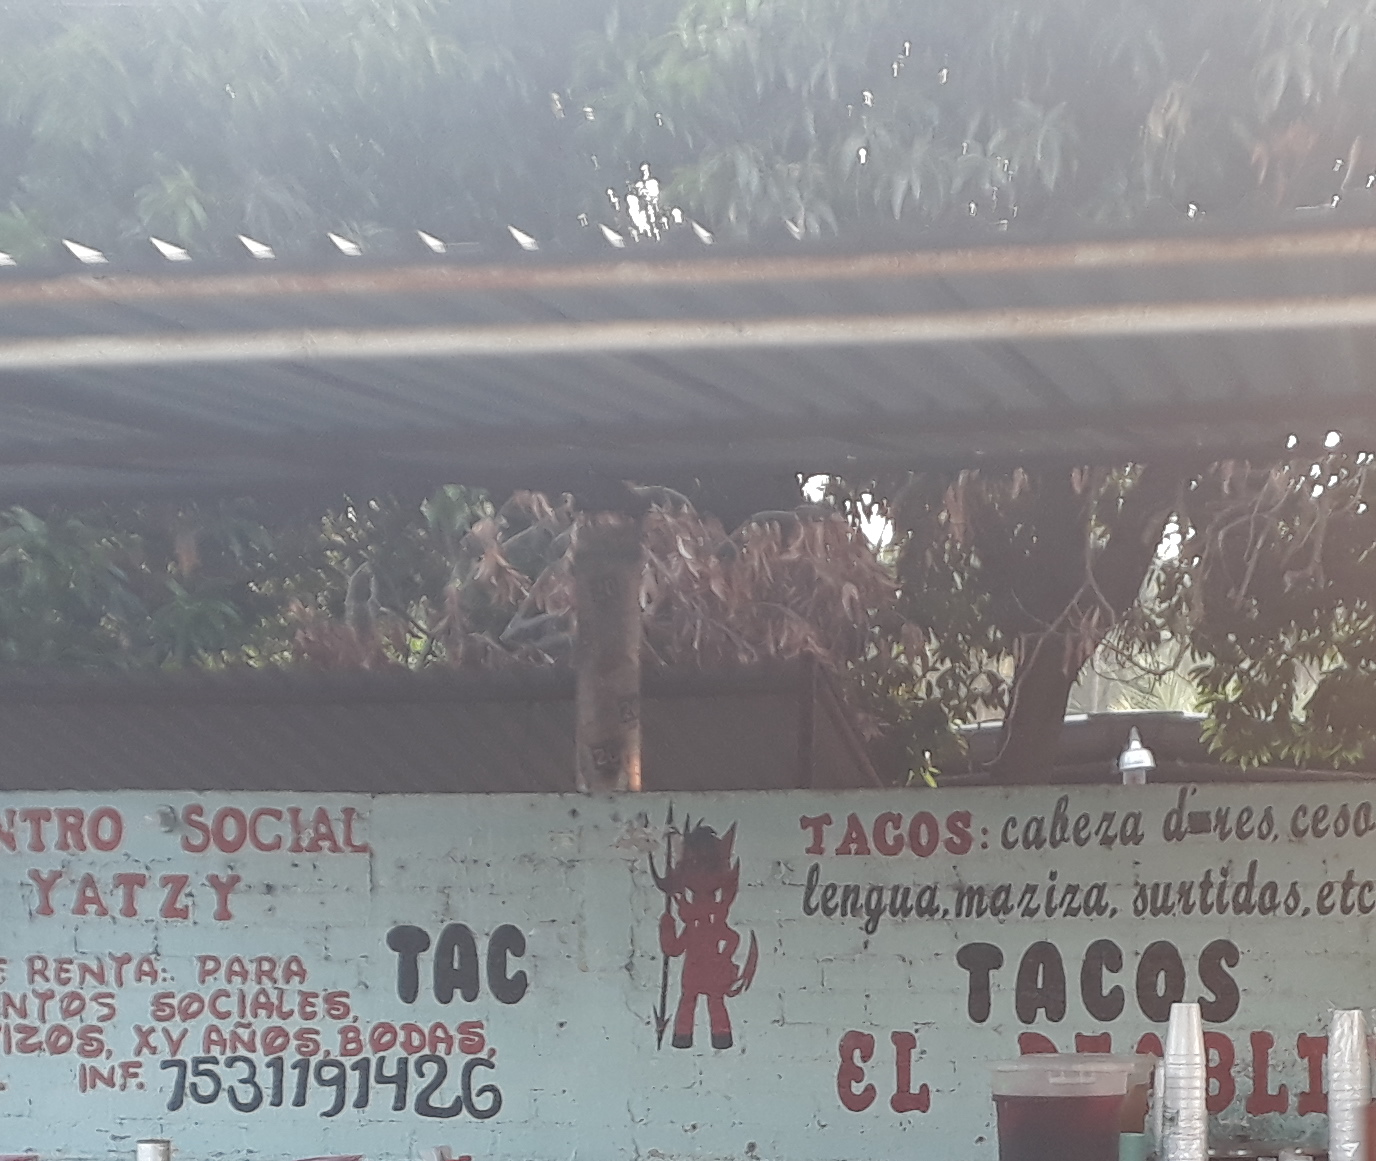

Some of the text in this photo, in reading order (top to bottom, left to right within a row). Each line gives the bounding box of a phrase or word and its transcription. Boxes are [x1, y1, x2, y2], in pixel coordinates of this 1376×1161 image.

[180, 803, 372, 853] SOCIAL
[1000, 794, 1145, 850] cabeza
[27, 868, 241, 921] YATZY
[197, 955, 308, 986] PARA
[387, 923, 529, 1005] TAC
[956, 939, 1241, 1024] TACOS
[132, 1023, 189, 1058] XV
[78, 1061, 145, 1093] INF.
[159, 1055, 503, 1119] 7531191426
[837, 1030, 931, 1114] EL
